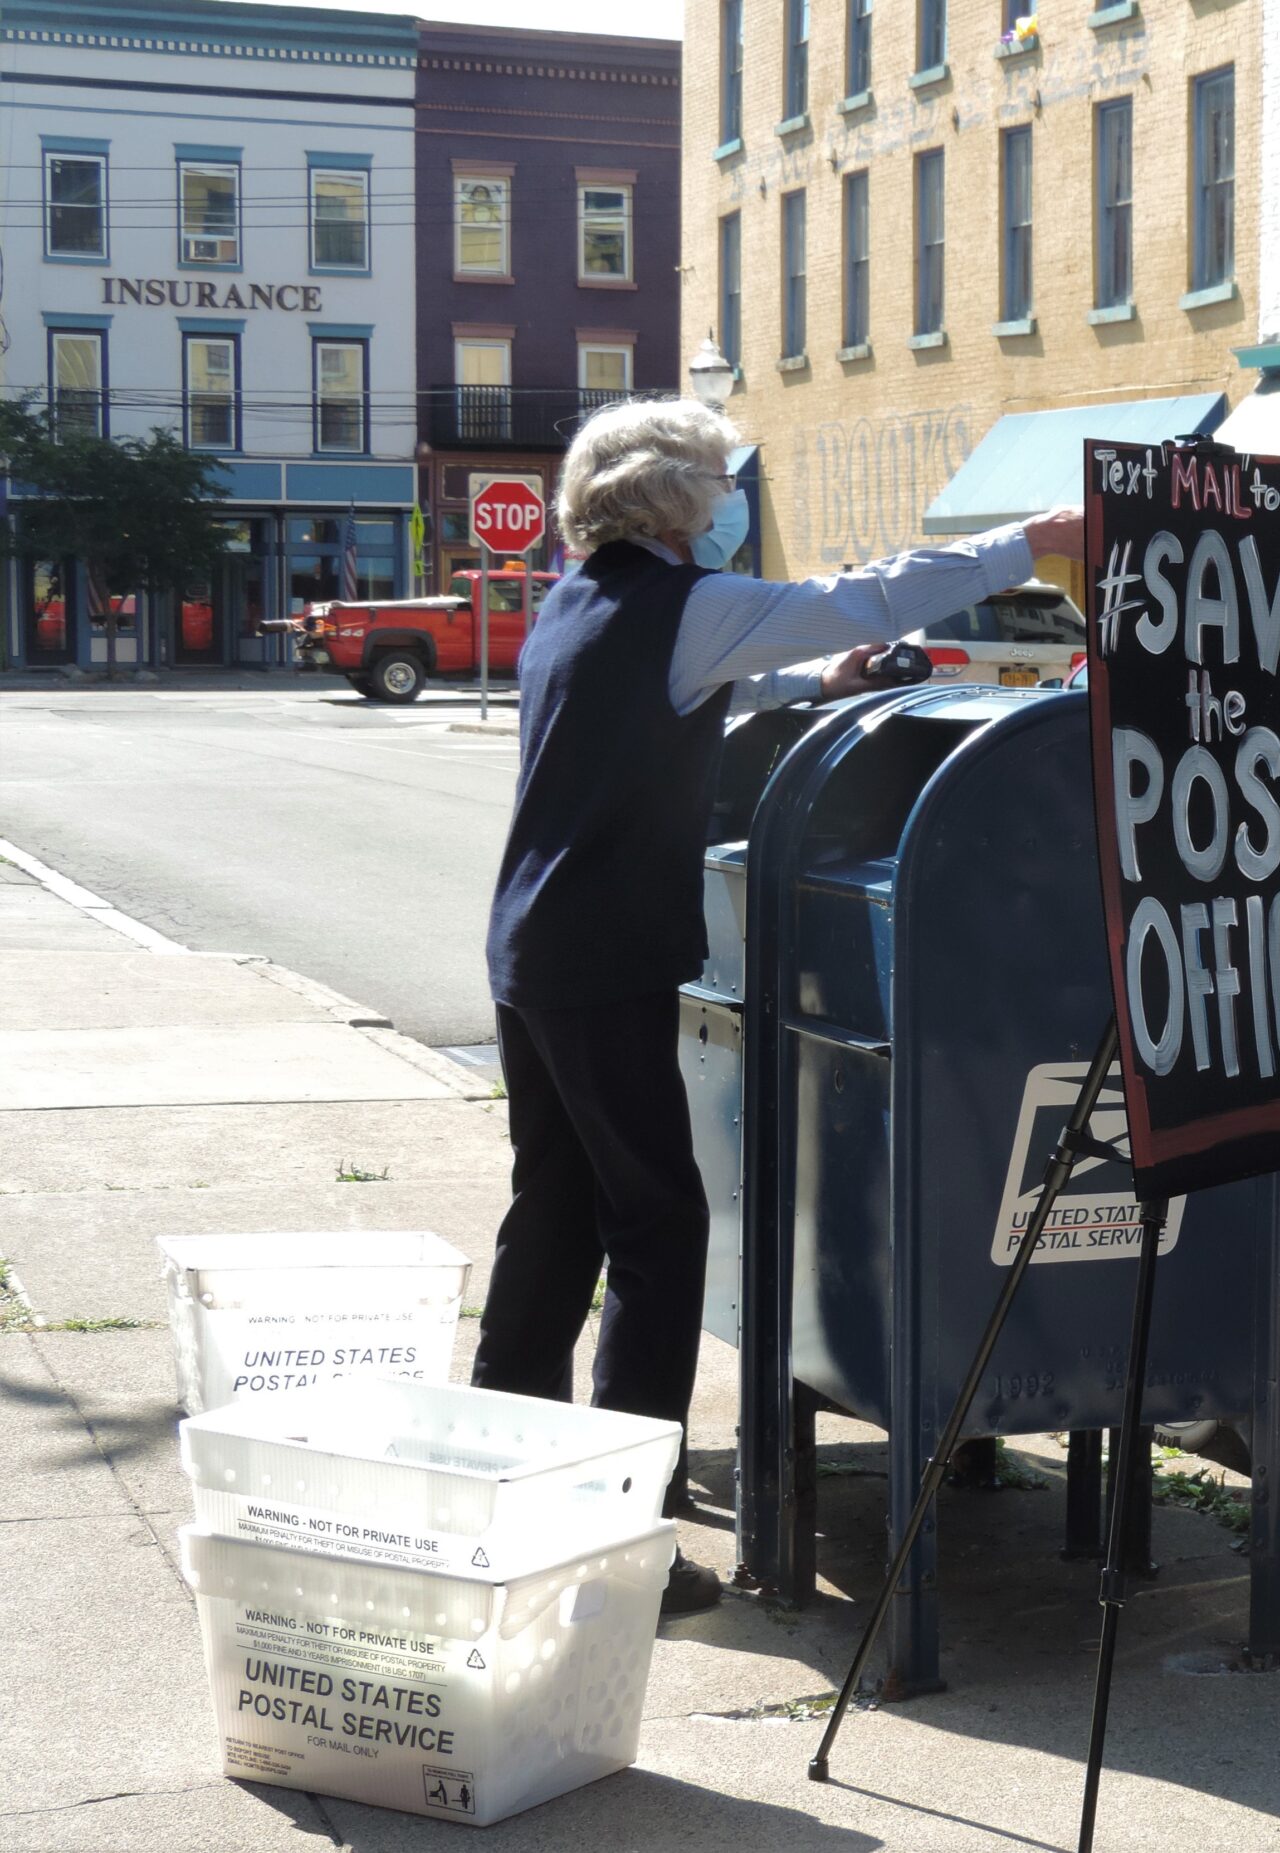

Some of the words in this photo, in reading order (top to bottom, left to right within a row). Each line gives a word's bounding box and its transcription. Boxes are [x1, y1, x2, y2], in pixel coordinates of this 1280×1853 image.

[101, 277, 322, 312] INSURANCE
[1093, 448, 1158, 499] Text
[1250, 468, 1280, 510] to
[476, 503, 540, 531] STOP
[1011, 647, 1035, 658] Jeep
[1186, 669, 1247, 742] the
[1011, 1207, 1089, 1229] UTED
[1006, 1231, 1083, 1252] PSTAL
[1087, 1224, 1166, 1246] SERVIE
[243, 1349, 326, 1368] UNITED
[332, 1347, 418, 1365] STATES
[247, 1505, 300, 1526] WARNING
[309, 1518, 333, 1532] NOT
[335, 1523, 359, 1538] FOR
[363, 1528, 411, 1547] PRIVATE
[415, 1538, 439, 1552] USE
[245, 1609, 297, 1629] WARNING
[306, 1622, 330, 1636] NOT
[332, 1627, 356, 1641] FOR
[359, 1631, 407, 1650] PRIVATE
[410, 1640, 435, 1655] USE
[380, 1655, 406, 1666] POSTAL
[407, 1660, 446, 1673] PROPERTY
[244, 1657, 334, 1697] UNITED
[341, 1677, 442, 1718] STATES
[238, 1689, 334, 1732] POSTAL
[341, 1712, 455, 1755] SERVICE
[307, 1735, 327, 1747] FOR
[328, 1740, 351, 1753] MAIL
[353, 1745, 380, 1759] ONLY
